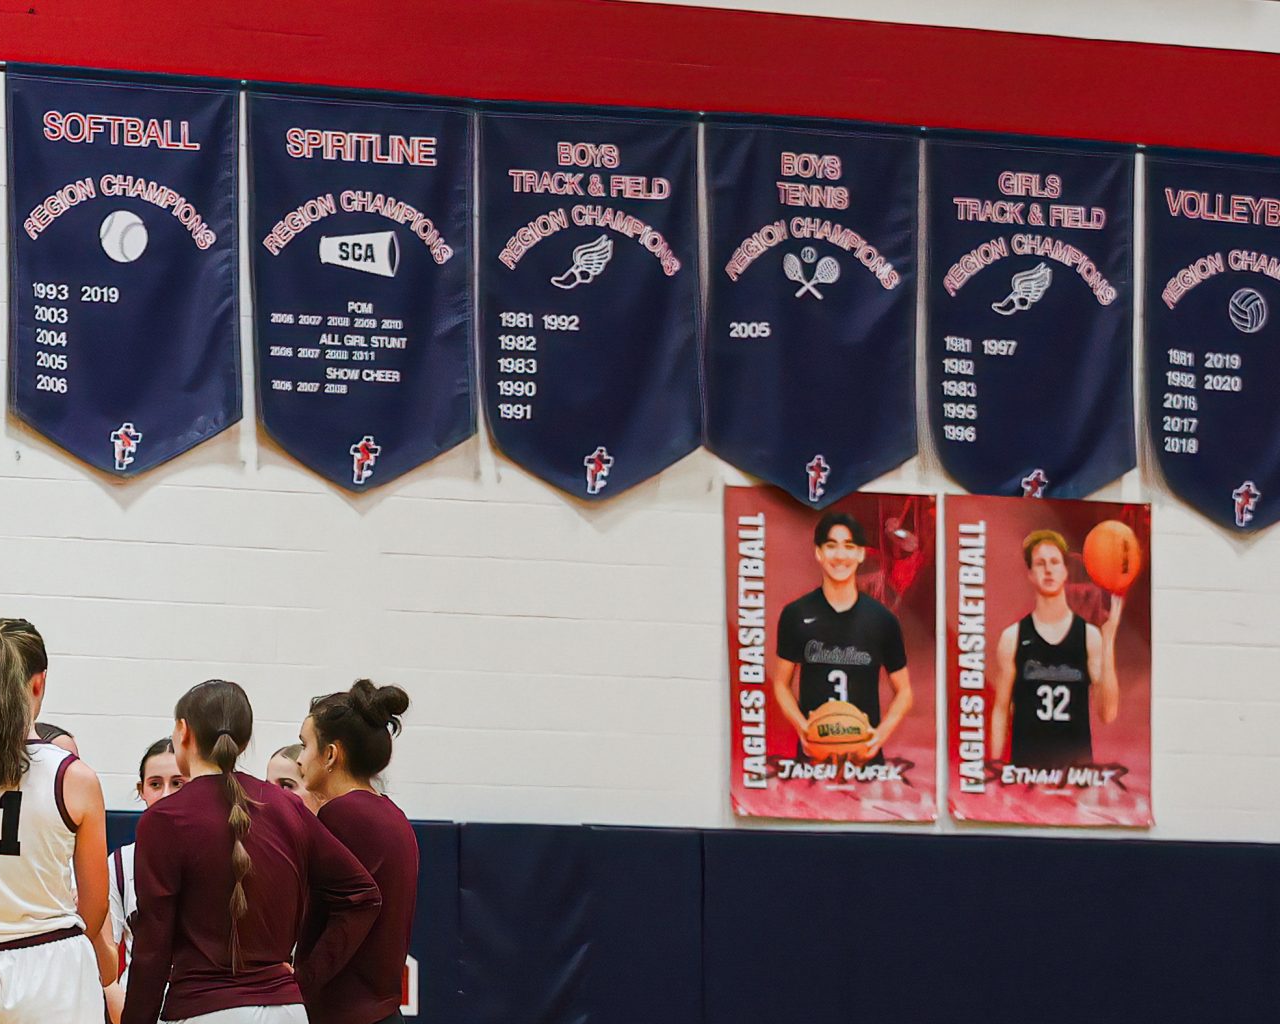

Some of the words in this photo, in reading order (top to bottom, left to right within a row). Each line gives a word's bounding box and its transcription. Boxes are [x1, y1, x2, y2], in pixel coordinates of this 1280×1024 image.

[43, 111, 200, 150] SOFTBALL
[287, 128, 437, 166] SPIRITLINE
[558, 142, 620, 168] BOYS
[778, 152, 841, 183] BOYS
[509, 170, 584, 195] TRACK
[588, 174, 605, 196] &
[611, 175, 670, 199] FIELD
[777, 179, 849, 209] TENNIS
[998, 171, 1061, 198] GIRLS
[23, 178, 95, 240] REGION
[100, 174, 217, 251] CHAMPIONS
[953, 194, 1026, 224] TRACK
[1028, 203, 1045, 225] &
[1050, 205, 1105, 229] FIELD
[262, 193, 335, 256] REGION
[340, 190, 454, 265] CHAMPIONS
[498, 209, 569, 270] REGION
[571, 205, 682, 277] CHAMPIONS
[338, 241, 376, 263] SCA
[724, 220, 788, 281] REGION
[790, 217, 902, 290] CHAMPIONS
[942, 237, 1007, 297] REGION
[1010, 233, 1118, 306] CHAMPIONS
[1162, 252, 1224, 310] REGION
[33, 283, 68, 300] 1993
[81, 286, 119, 302] 2019
[35, 305, 68, 323] 2003
[348, 302, 373, 313] POM
[500, 312, 533, 327] 1981
[542, 315, 579, 330] 1992
[730, 322, 771, 338] 2005
[37, 328, 67, 346] 2004
[319, 334, 341, 345] ALL
[344, 335, 368, 346] GIRL
[371, 336, 407, 348] STUNT
[499, 335, 536, 350] 1982
[944, 336, 971, 352] 1981
[982, 340, 1017, 355] 1997
[37, 351, 67, 370] 2005
[353, 351, 375, 360] 2011
[1205, 353, 1241, 368] 2019
[326, 368, 360, 379] SHOW
[362, 370, 400, 382] CHEER
[498, 358, 536, 373] 1983
[943, 359, 974, 375] 1982
[37, 375, 67, 393] 2006
[497, 381, 536, 396] 1990
[942, 381, 976, 397] 1983
[1205, 375, 1241, 391] 2020
[944, 403, 976, 419] 1995
[1164, 393, 1197, 410] 2016
[498, 404, 531, 419] 1991
[944, 425, 976, 441] 1996
[1164, 416, 1197, 432] 2017
[1165, 437, 1198, 453] 2018
[738, 512, 765, 683] BASKETBALL
[958, 520, 986, 689] BASKETBALL
[1036, 685, 1071, 721] 32
[740, 690, 767, 789] EAGLES
[959, 695, 985, 793] EAGLES
[778, 760, 837, 780] JADEN
[1001, 764, 1062, 784] ETHAN
[1067, 765, 1115, 785] WILT
